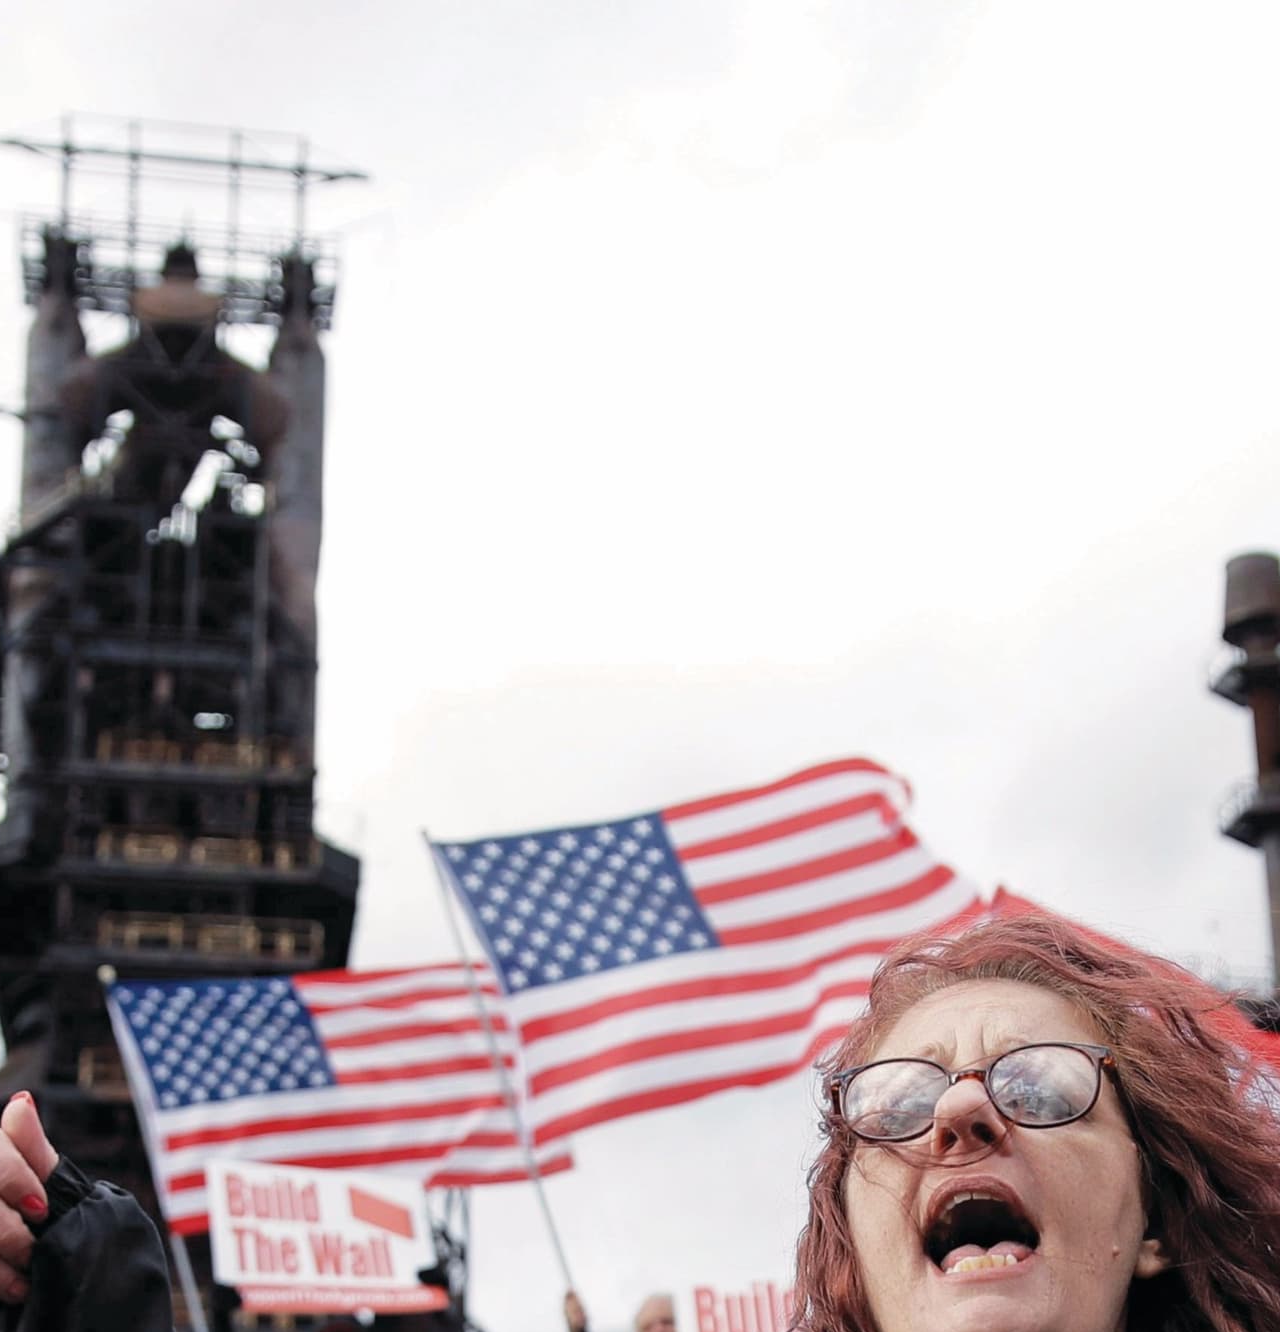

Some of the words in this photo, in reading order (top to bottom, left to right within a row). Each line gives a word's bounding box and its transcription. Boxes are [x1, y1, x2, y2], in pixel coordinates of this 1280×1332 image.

[225, 1172, 320, 1222] Build
[233, 1227, 298, 1274] The
[309, 1230, 393, 1277] Wall
